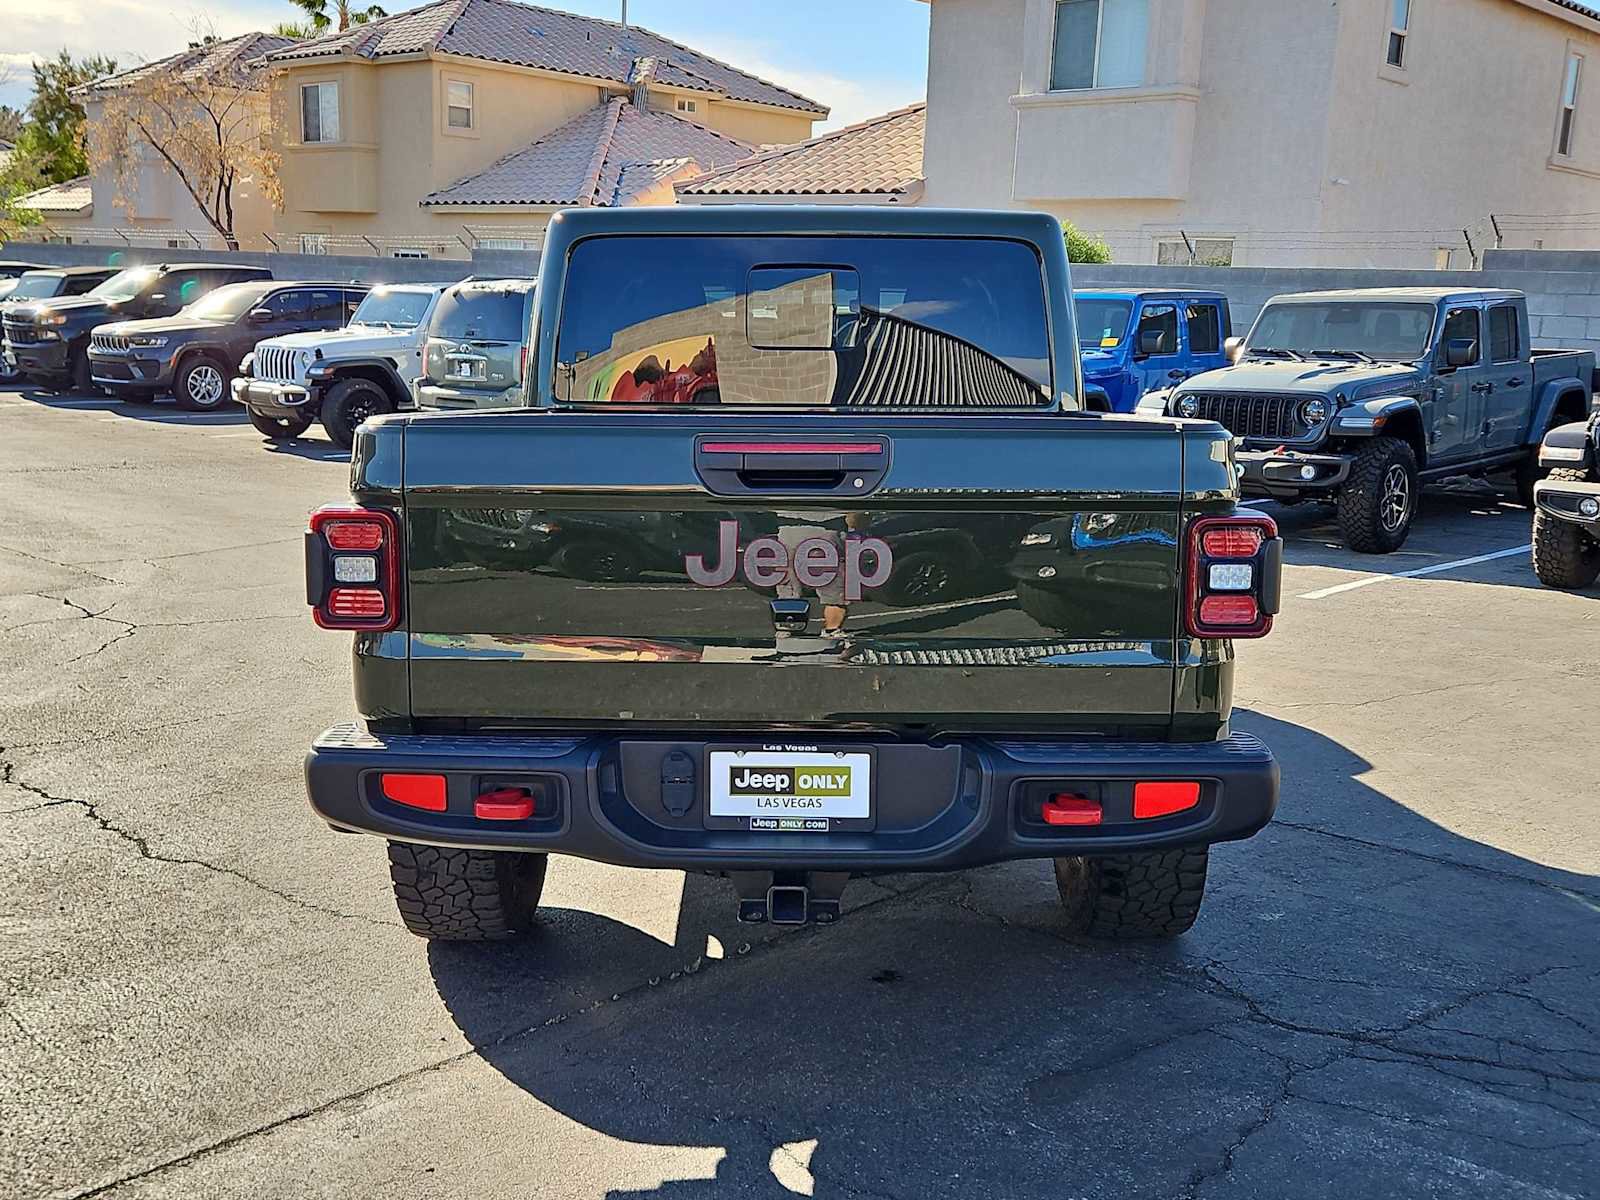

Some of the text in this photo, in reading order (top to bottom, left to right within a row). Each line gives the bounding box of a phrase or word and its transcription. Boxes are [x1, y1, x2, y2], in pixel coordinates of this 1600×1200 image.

[685, 519, 893, 601] Jeep
[784, 744, 818, 752] Vegas
[734, 769, 848, 792] Jeep ONLY
[757, 798, 822, 808] LAS VEGAS
[752, 818, 777, 829] Jeep
